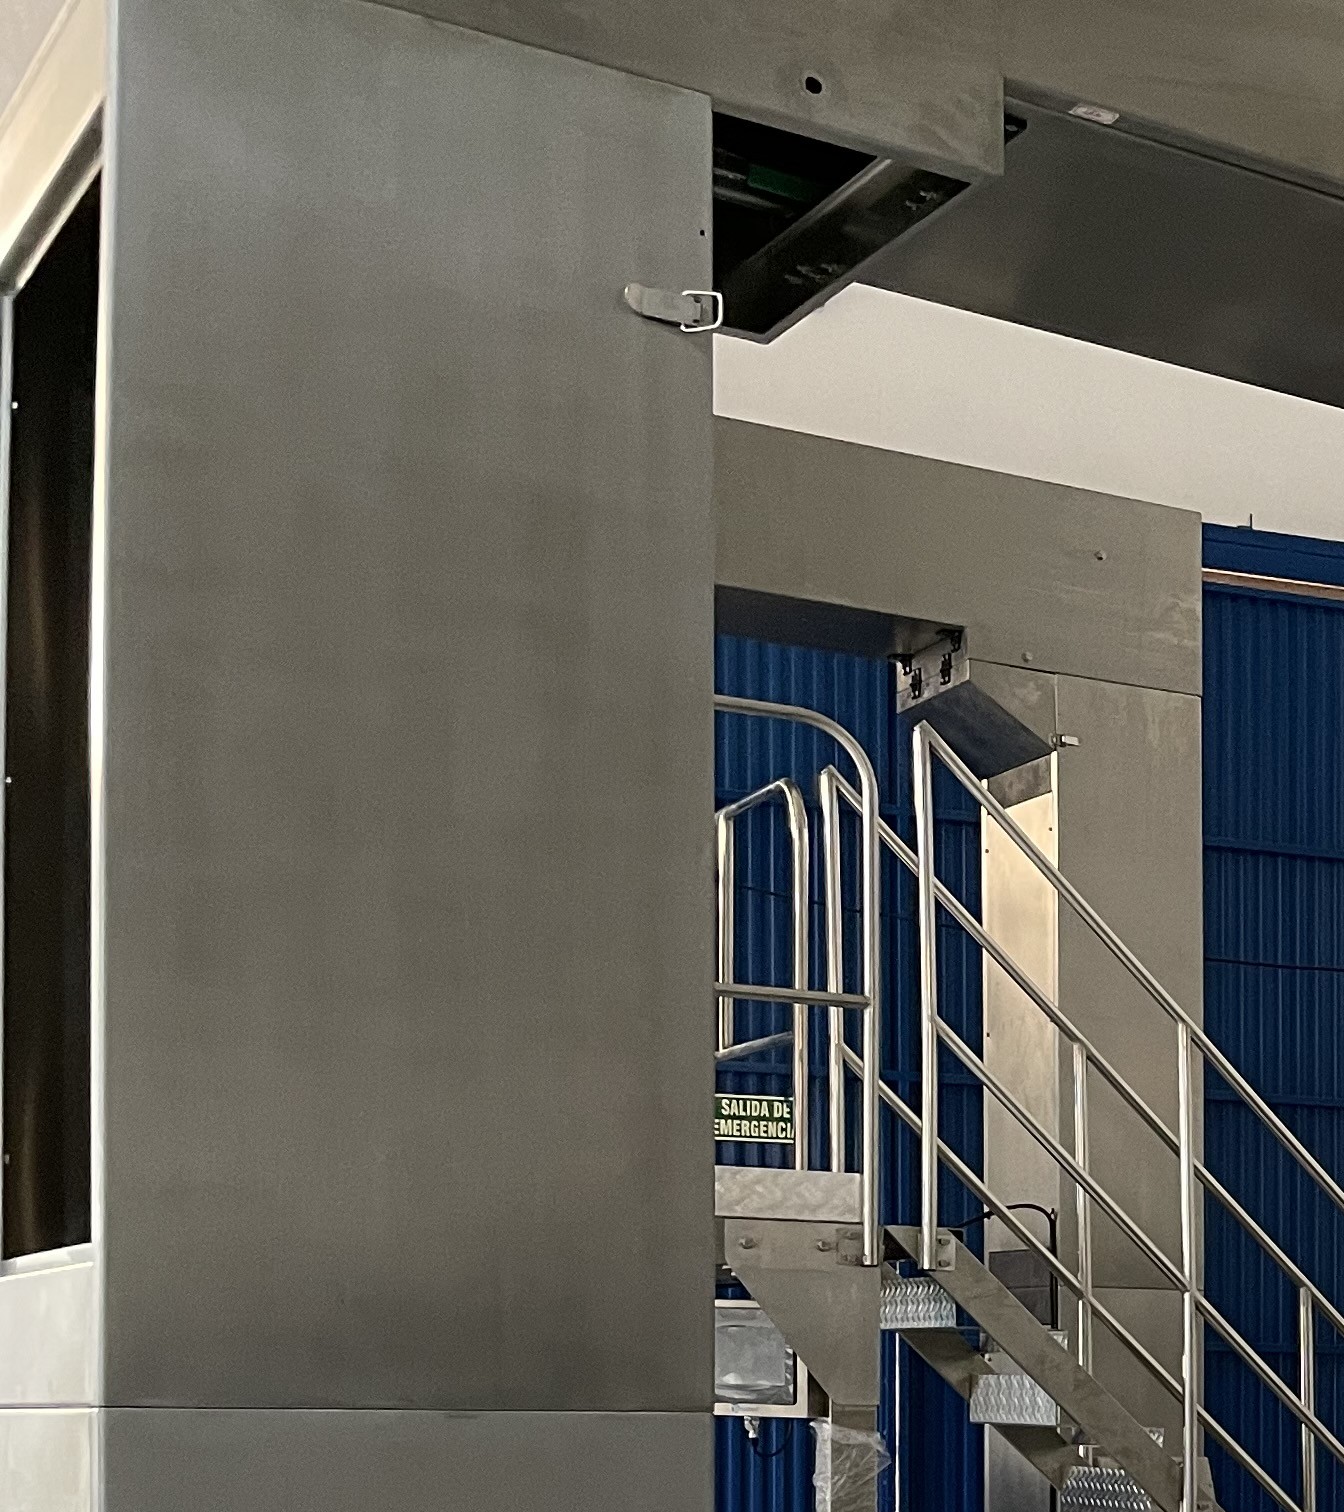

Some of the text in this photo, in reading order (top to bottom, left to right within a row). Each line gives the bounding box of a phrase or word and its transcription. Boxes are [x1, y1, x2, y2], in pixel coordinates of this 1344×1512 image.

[721, 1099, 791, 1118] SALIDA DE
[714, 1118, 795, 1138] EMERGENCI
